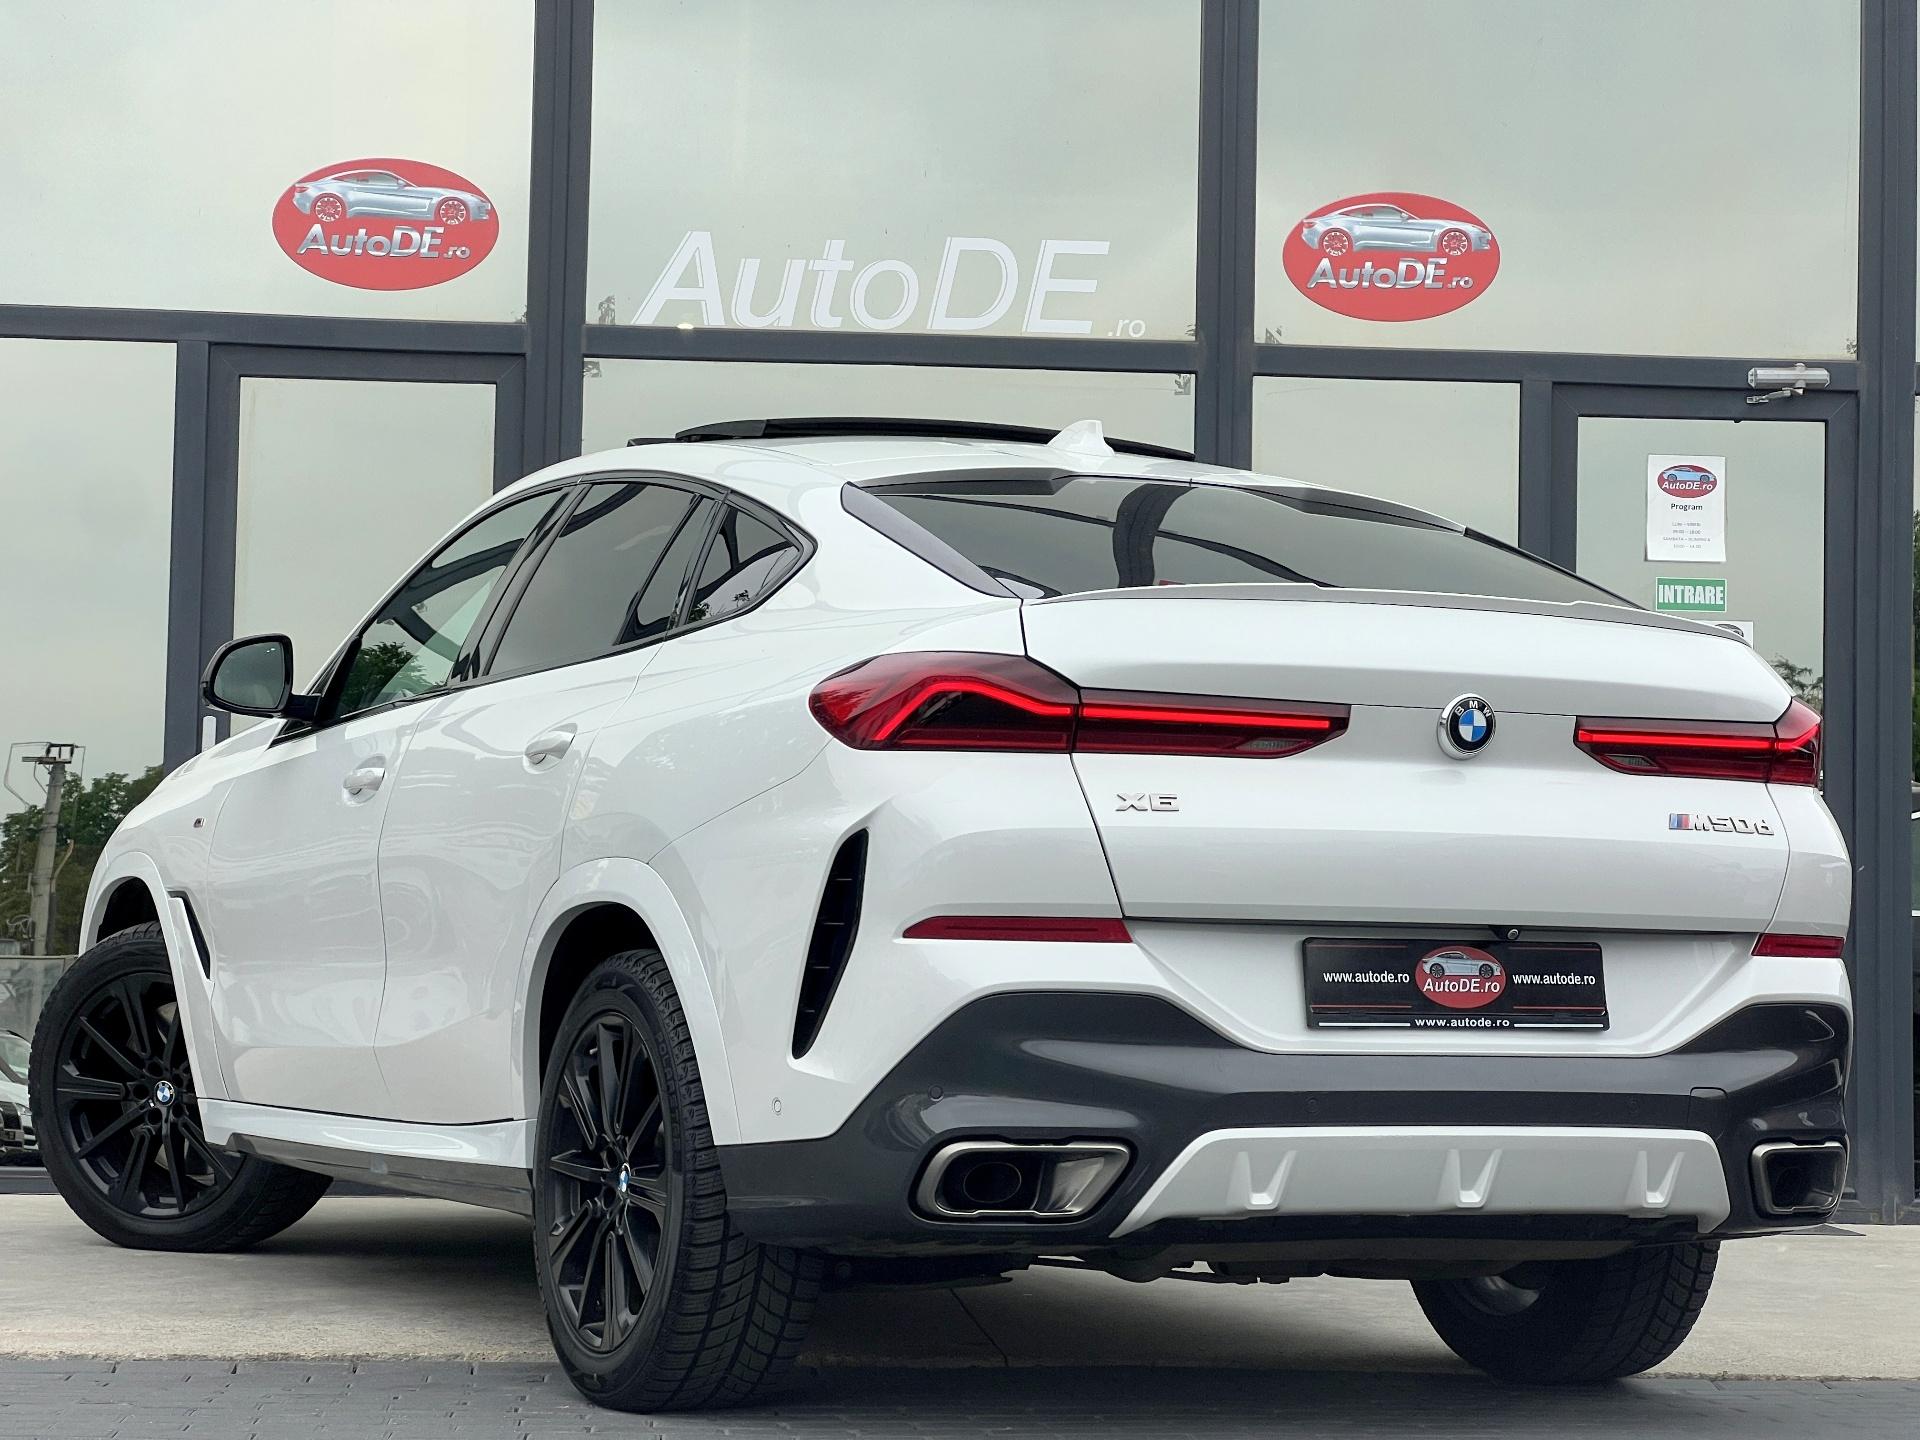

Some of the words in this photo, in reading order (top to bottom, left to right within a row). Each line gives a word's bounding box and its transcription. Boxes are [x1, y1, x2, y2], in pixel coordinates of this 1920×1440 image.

[1670, 503, 1703, 512] Program
[1658, 584, 1724, 605] INTRARE
[1454, 700, 1492, 718] BMW
[1115, 793, 1180, 812] X6
[1323, 970, 1410, 984] www.autode.ro
[1512, 971, 1596, 986] www.autode.ro
[1423, 977, 1500, 994] AutoDE.ro
[1415, 1016, 1510, 1028] www.autode.ro
